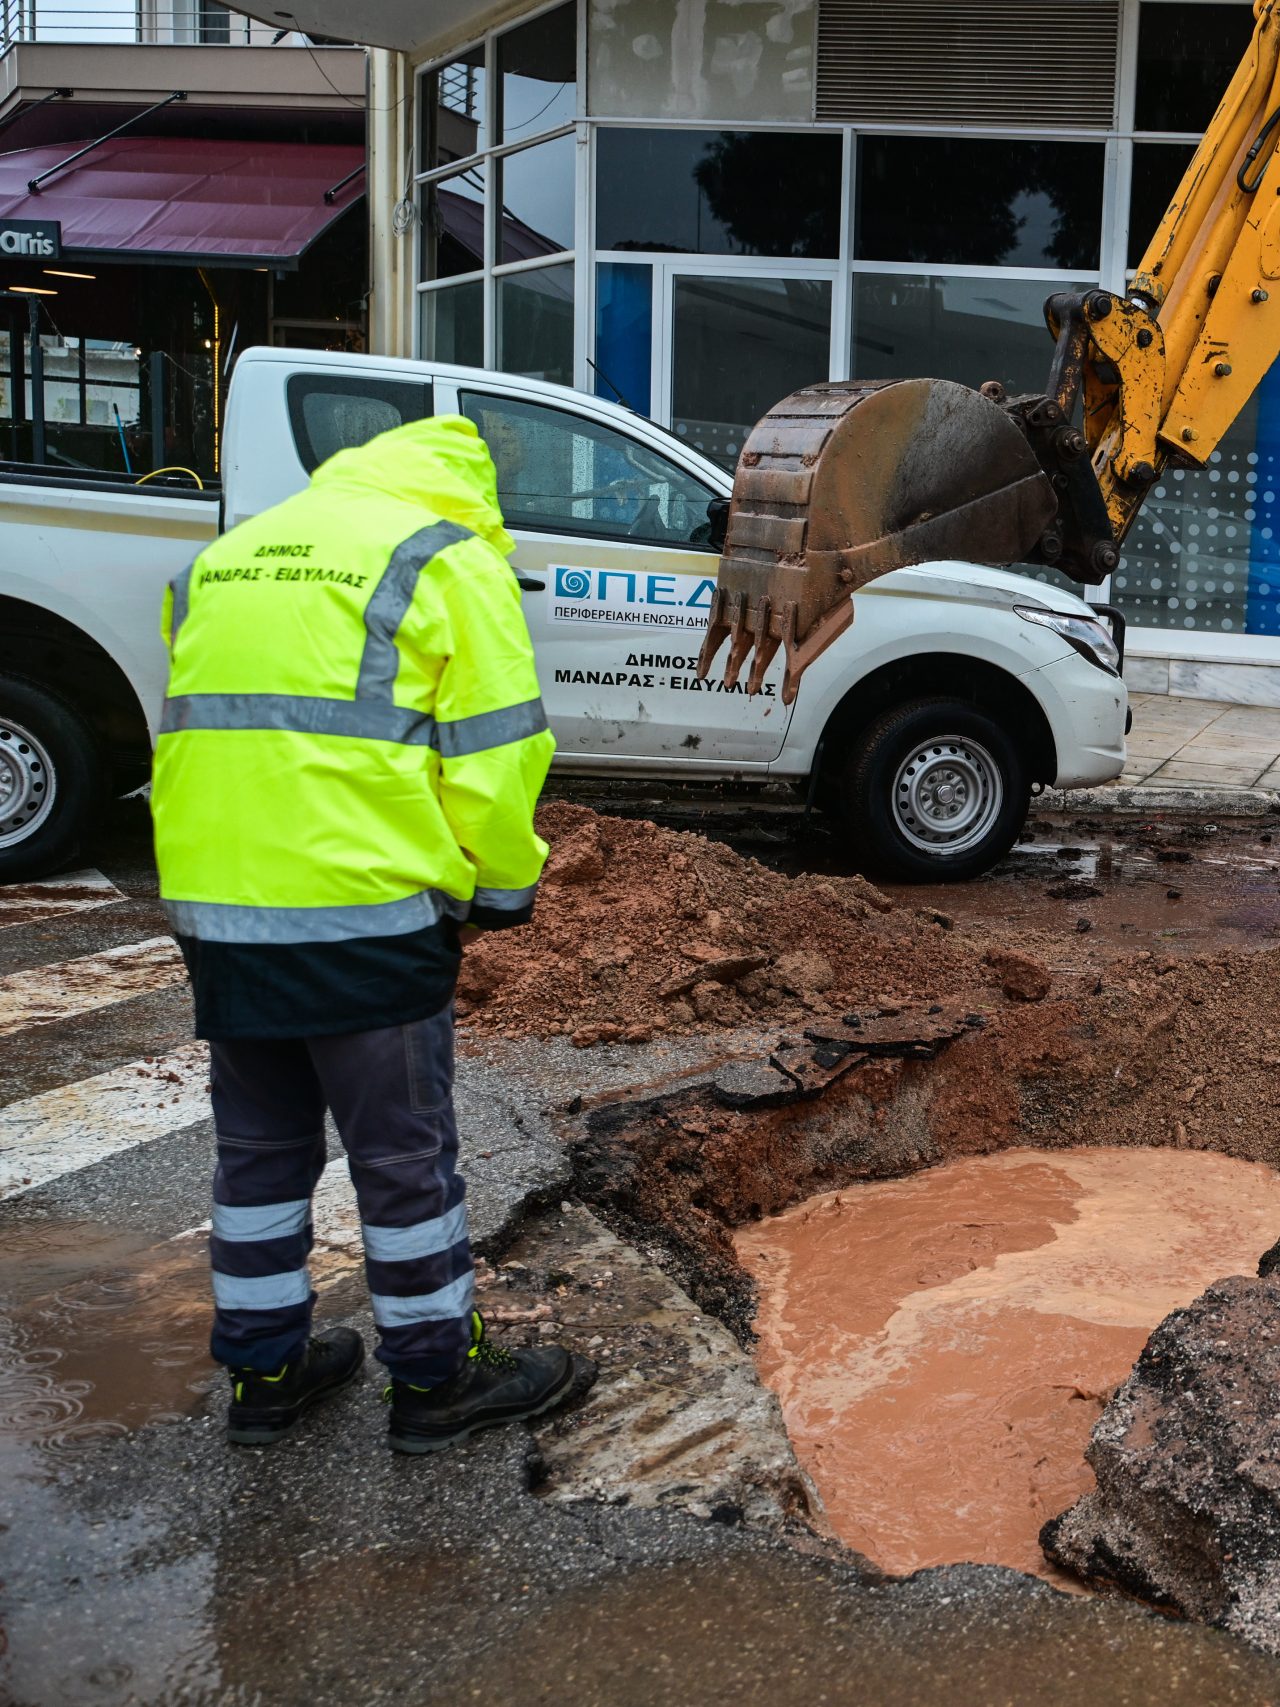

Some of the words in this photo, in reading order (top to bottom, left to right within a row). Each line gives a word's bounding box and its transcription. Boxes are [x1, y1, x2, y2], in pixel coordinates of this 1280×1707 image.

[253, 545, 314, 558] ΔΗΜΟΣ
[275, 567, 369, 589] ΕΙΔΥΛΛΙΑΣ
[554, 606, 641, 623] ΠΕΡΙΦΕΡΕΙΑΚΗ
[643, 613, 684, 626] ΕΝΩΣΗ
[625, 653, 698, 671] ΔΗΜΟΣ
[554, 669, 655, 688] ΜΑΝΔΡΑΣ
